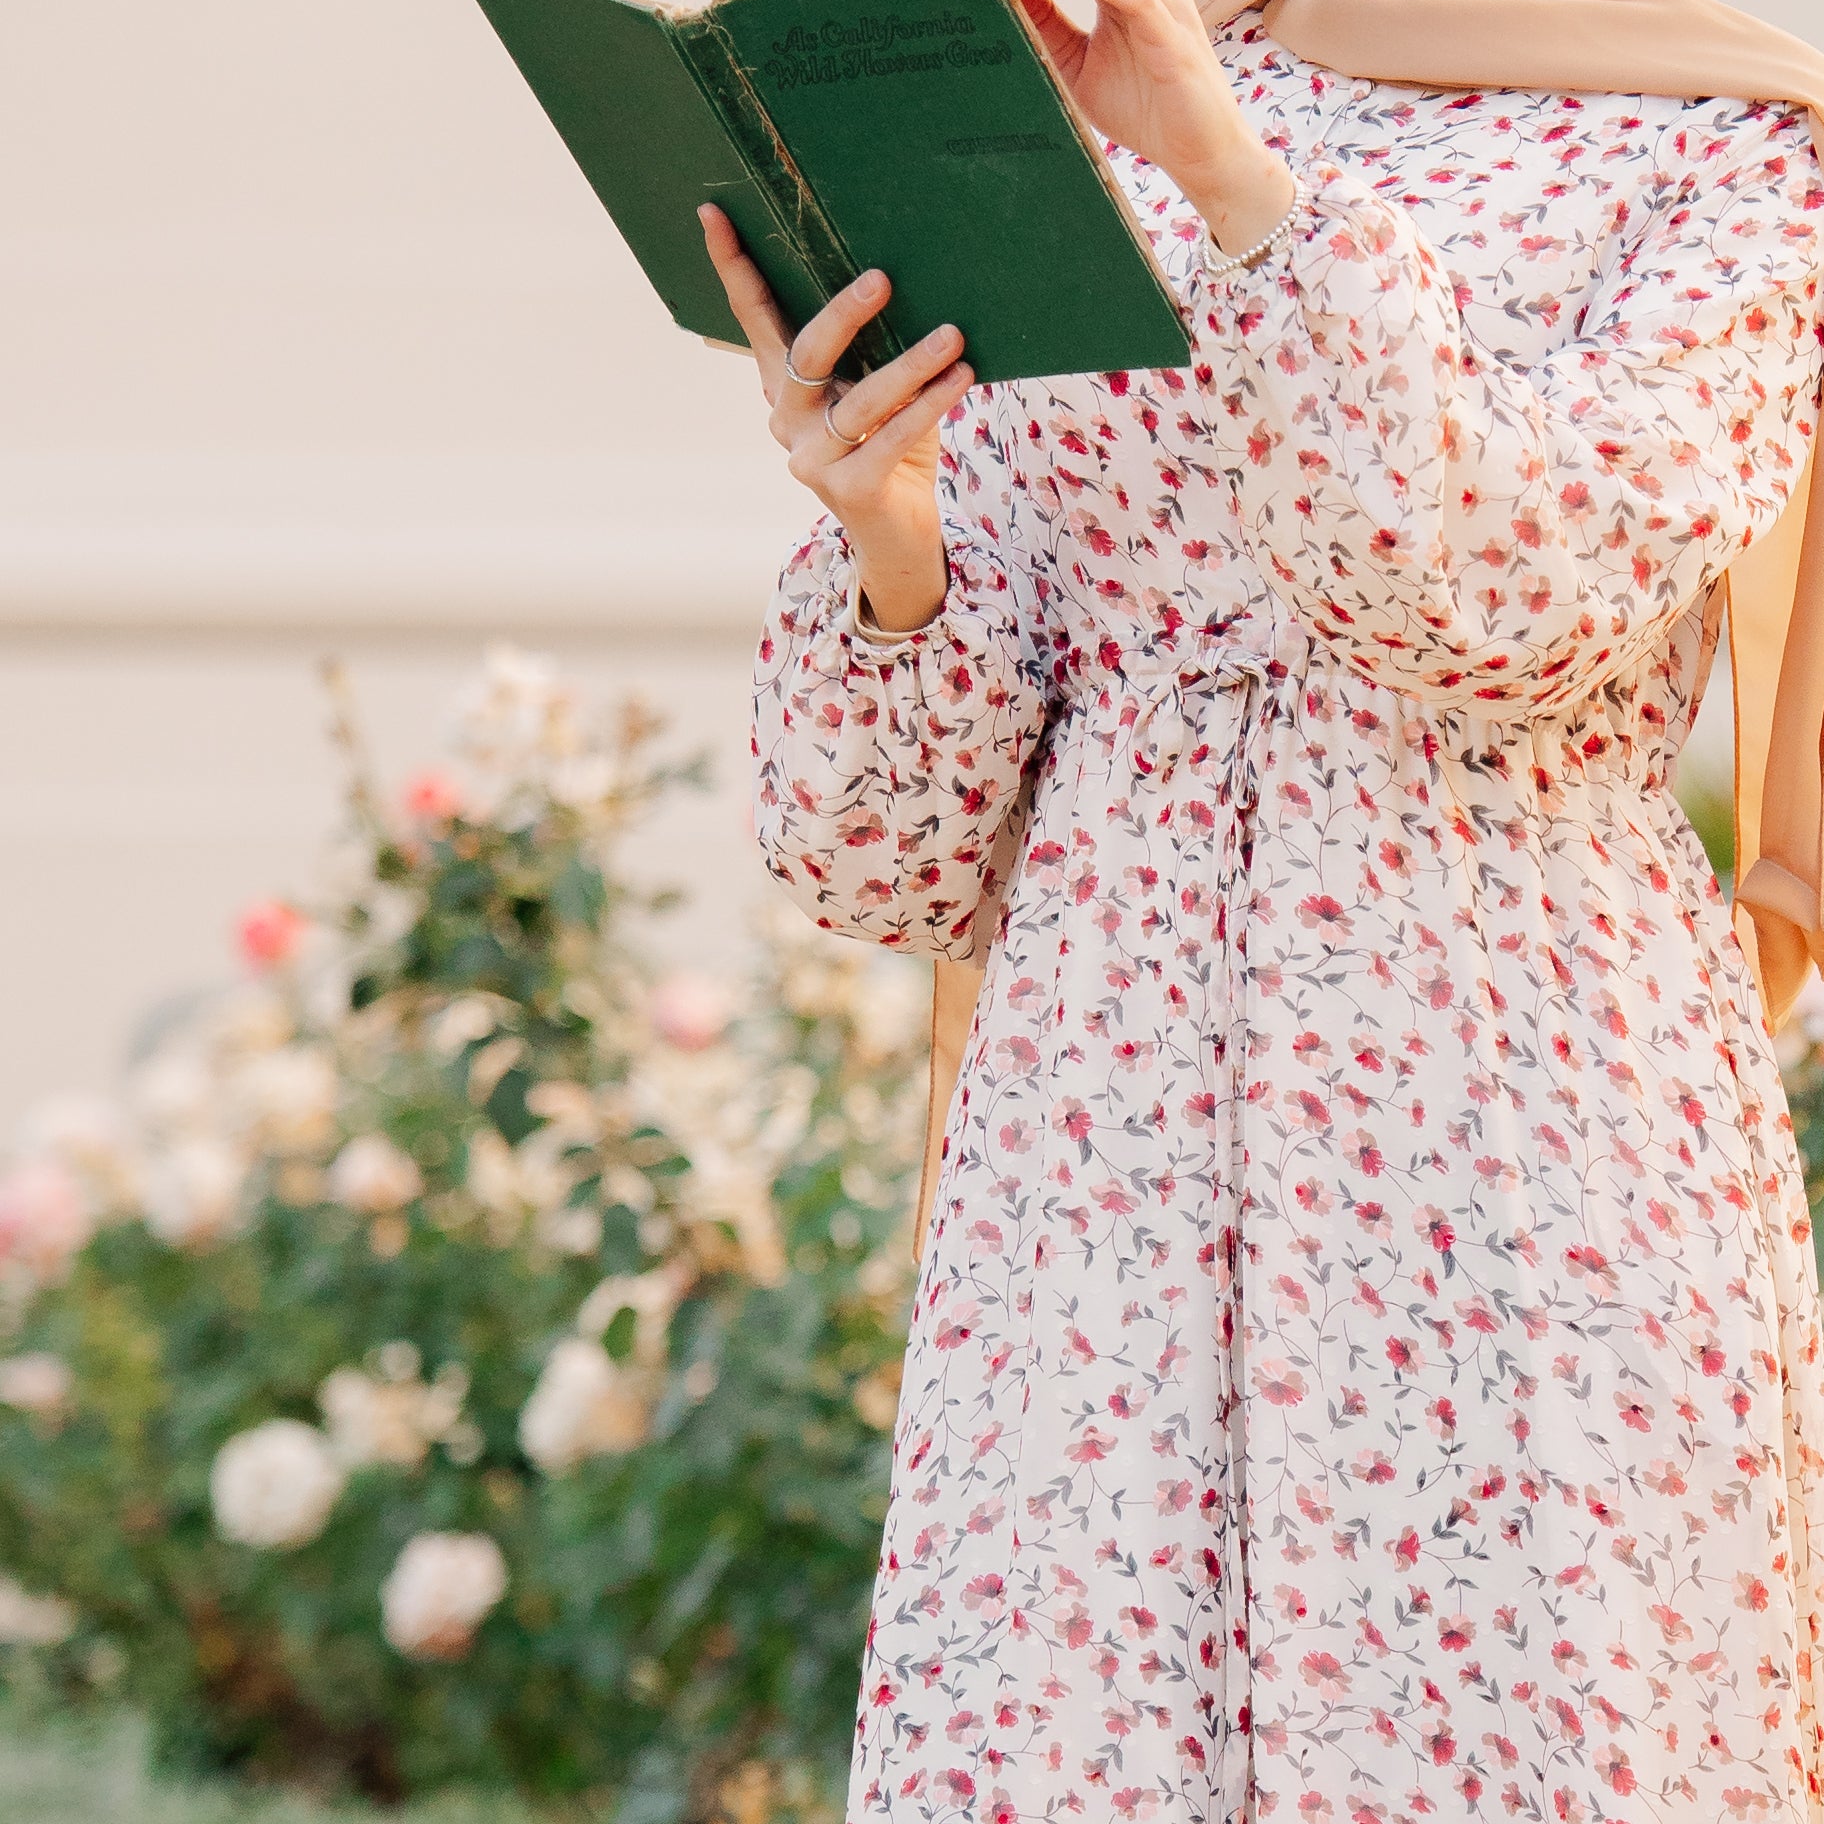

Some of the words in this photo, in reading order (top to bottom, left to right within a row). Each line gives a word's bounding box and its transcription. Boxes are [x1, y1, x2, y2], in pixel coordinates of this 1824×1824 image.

[772, 25, 819, 55] As
[820, 11, 977, 52] California
[763, 55, 841, 90] Wild
[840, 47, 945, 80] Flowers
[944, 39, 1012, 68] Grow
